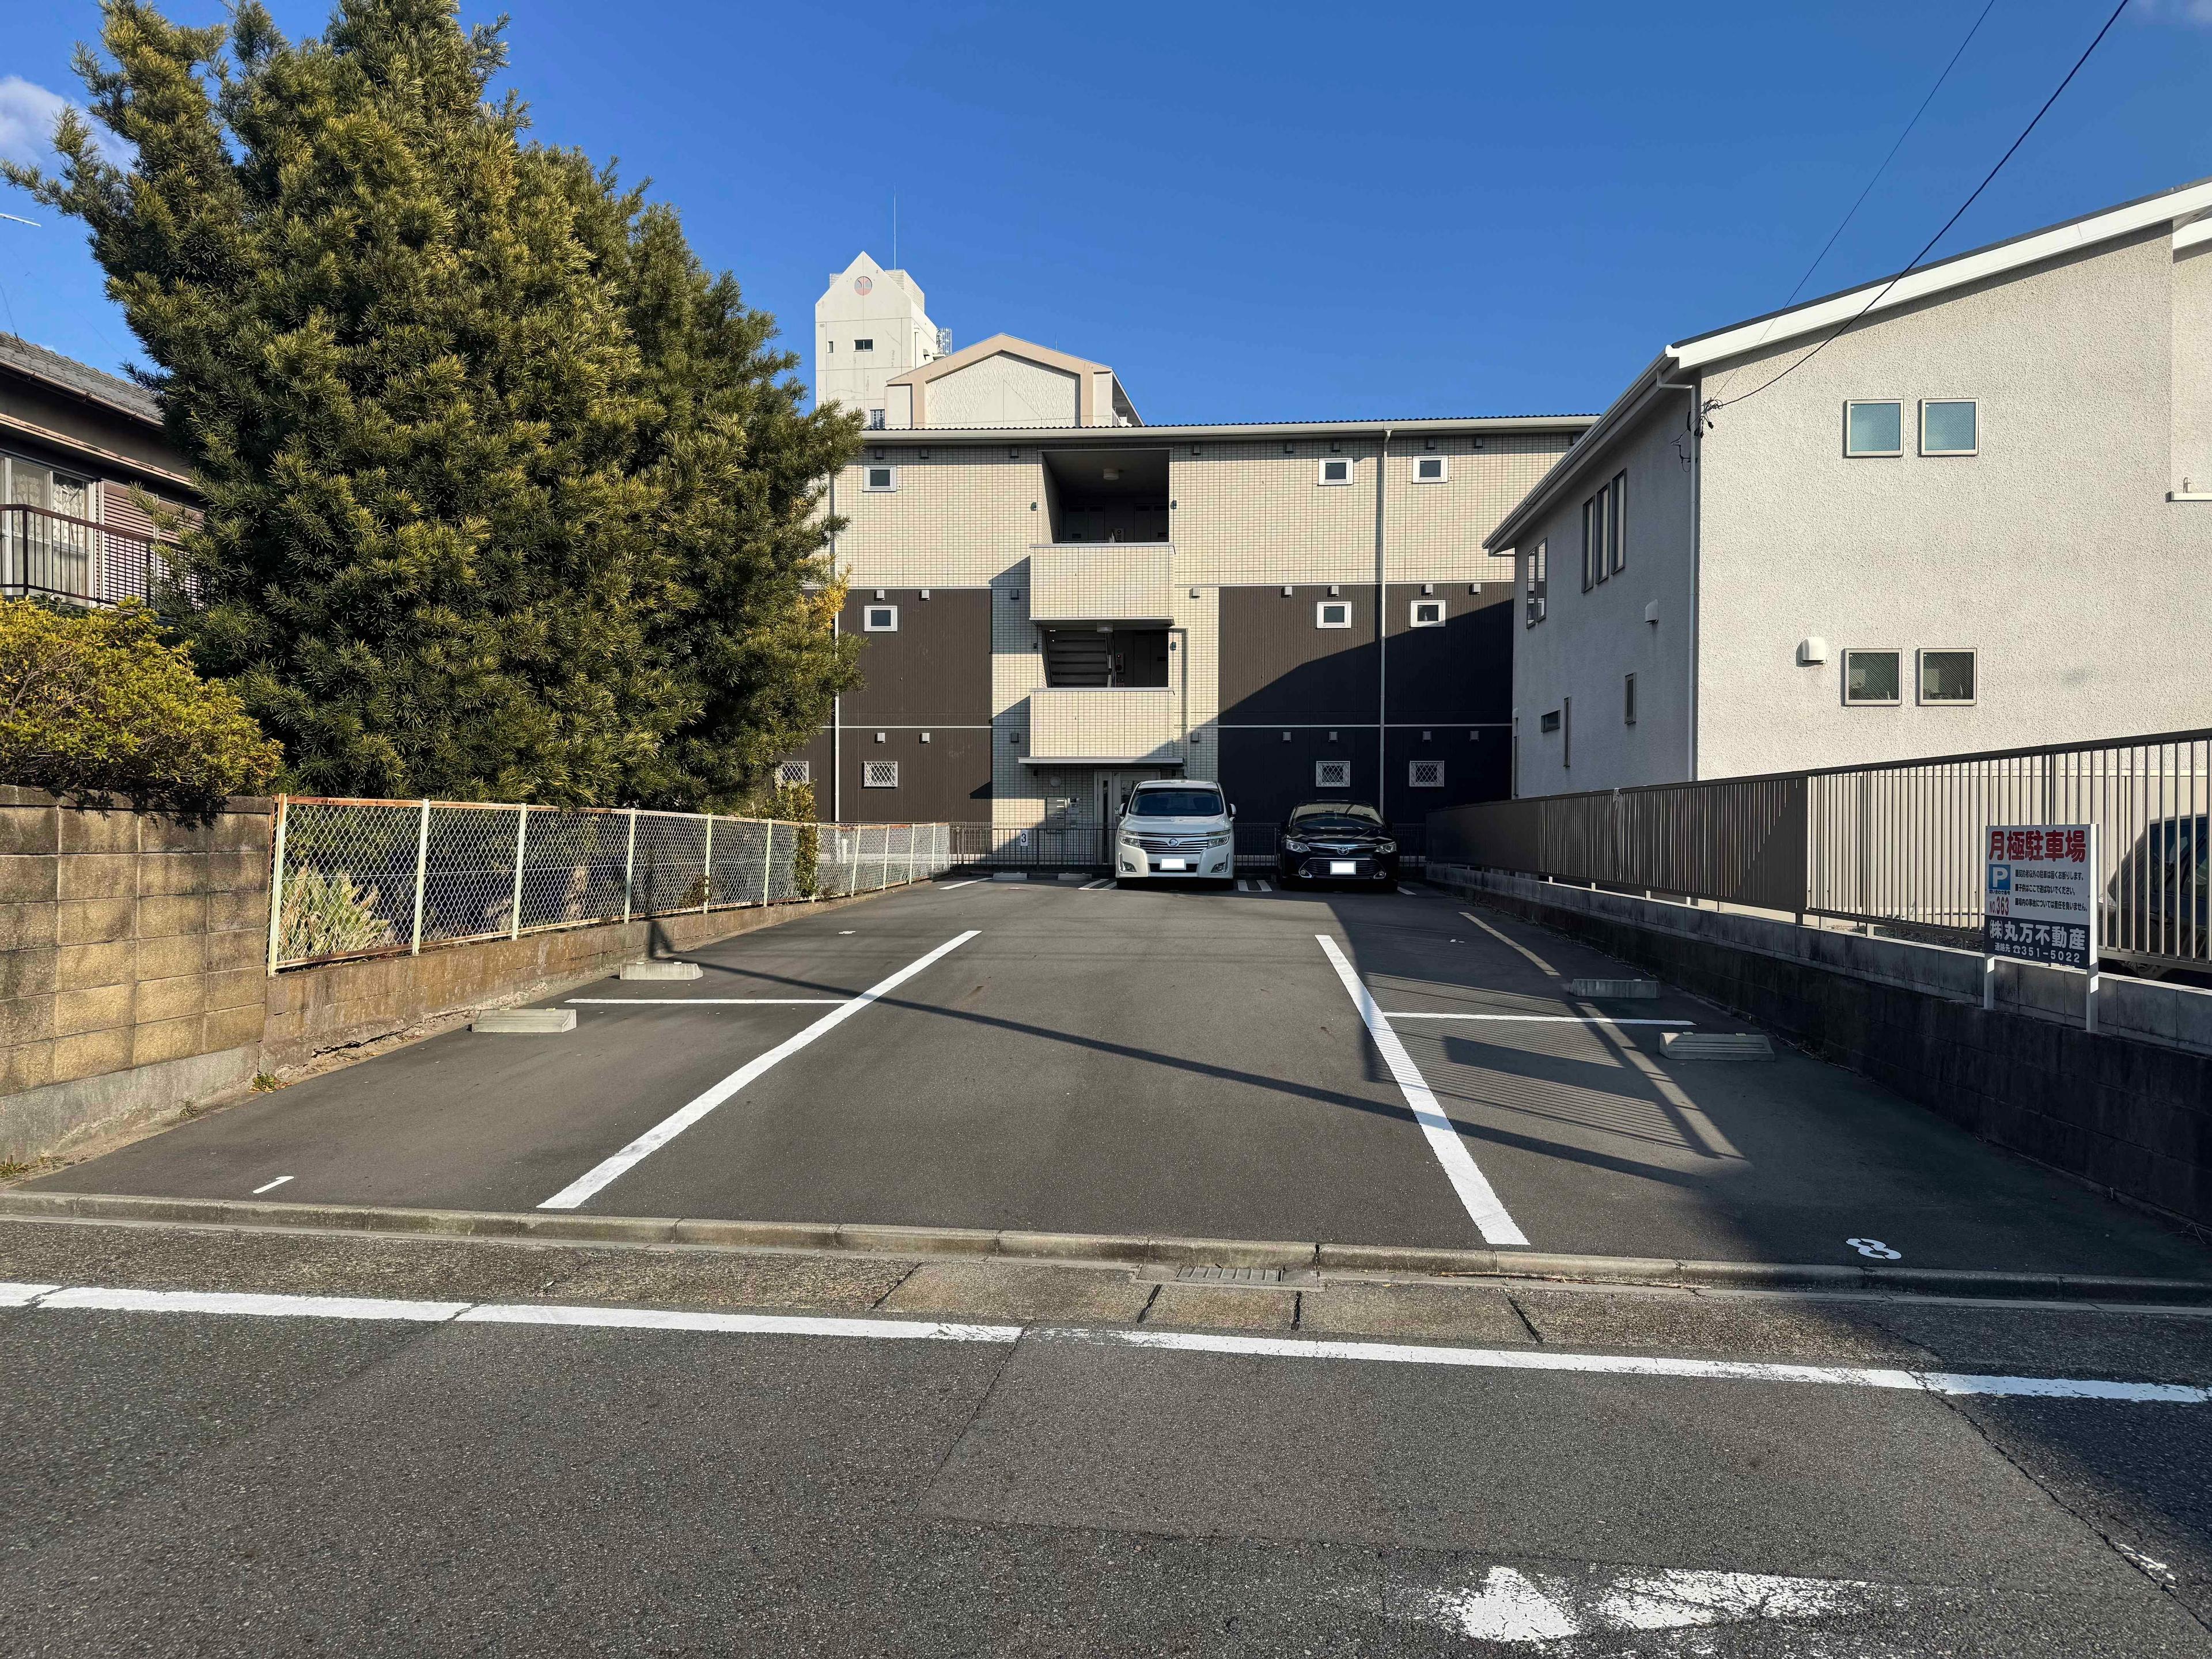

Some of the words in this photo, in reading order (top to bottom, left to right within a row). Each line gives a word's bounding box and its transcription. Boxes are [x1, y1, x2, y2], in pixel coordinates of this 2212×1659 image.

[1021, 833, 1026, 842] 3
[1988, 830, 2086, 863] 月極駐車場
[1993, 867, 2008, 888] P
[1995, 942, 2011, 953] 連絡先
[1846, 1238, 1902, 1259] 8
